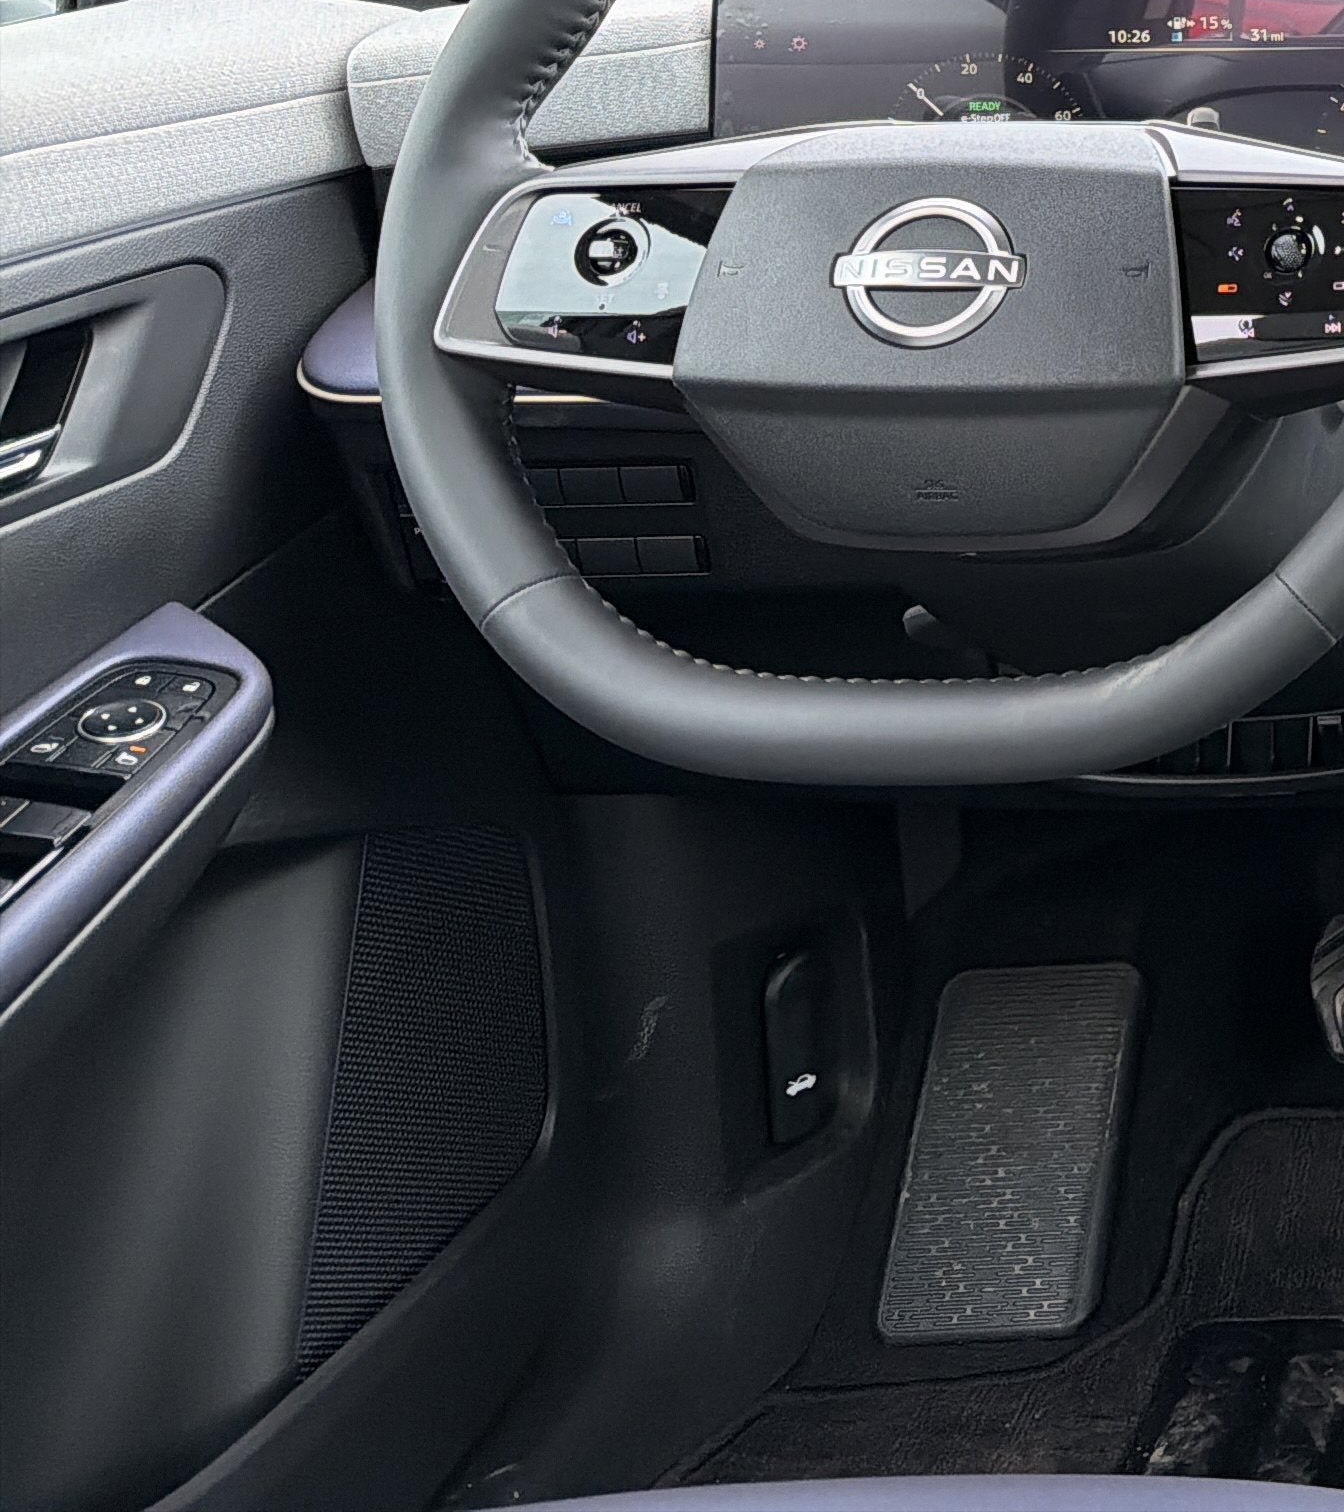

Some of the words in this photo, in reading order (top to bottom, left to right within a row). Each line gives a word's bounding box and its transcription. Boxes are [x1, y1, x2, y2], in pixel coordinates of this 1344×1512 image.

[1108, 30, 1150, 43] 10:26
[1250, 29, 1269, 42] 31
[1271, 31, 1284, 42] mi
[961, 64, 977, 74] 20
[1017, 73, 1033, 83] 40
[969, 102, 1001, 111] READY
[1055, 111, 1071, 121] 60
[610, 202, 642, 213] ANCEL
[839, 256, 1019, 282] NISSAN
